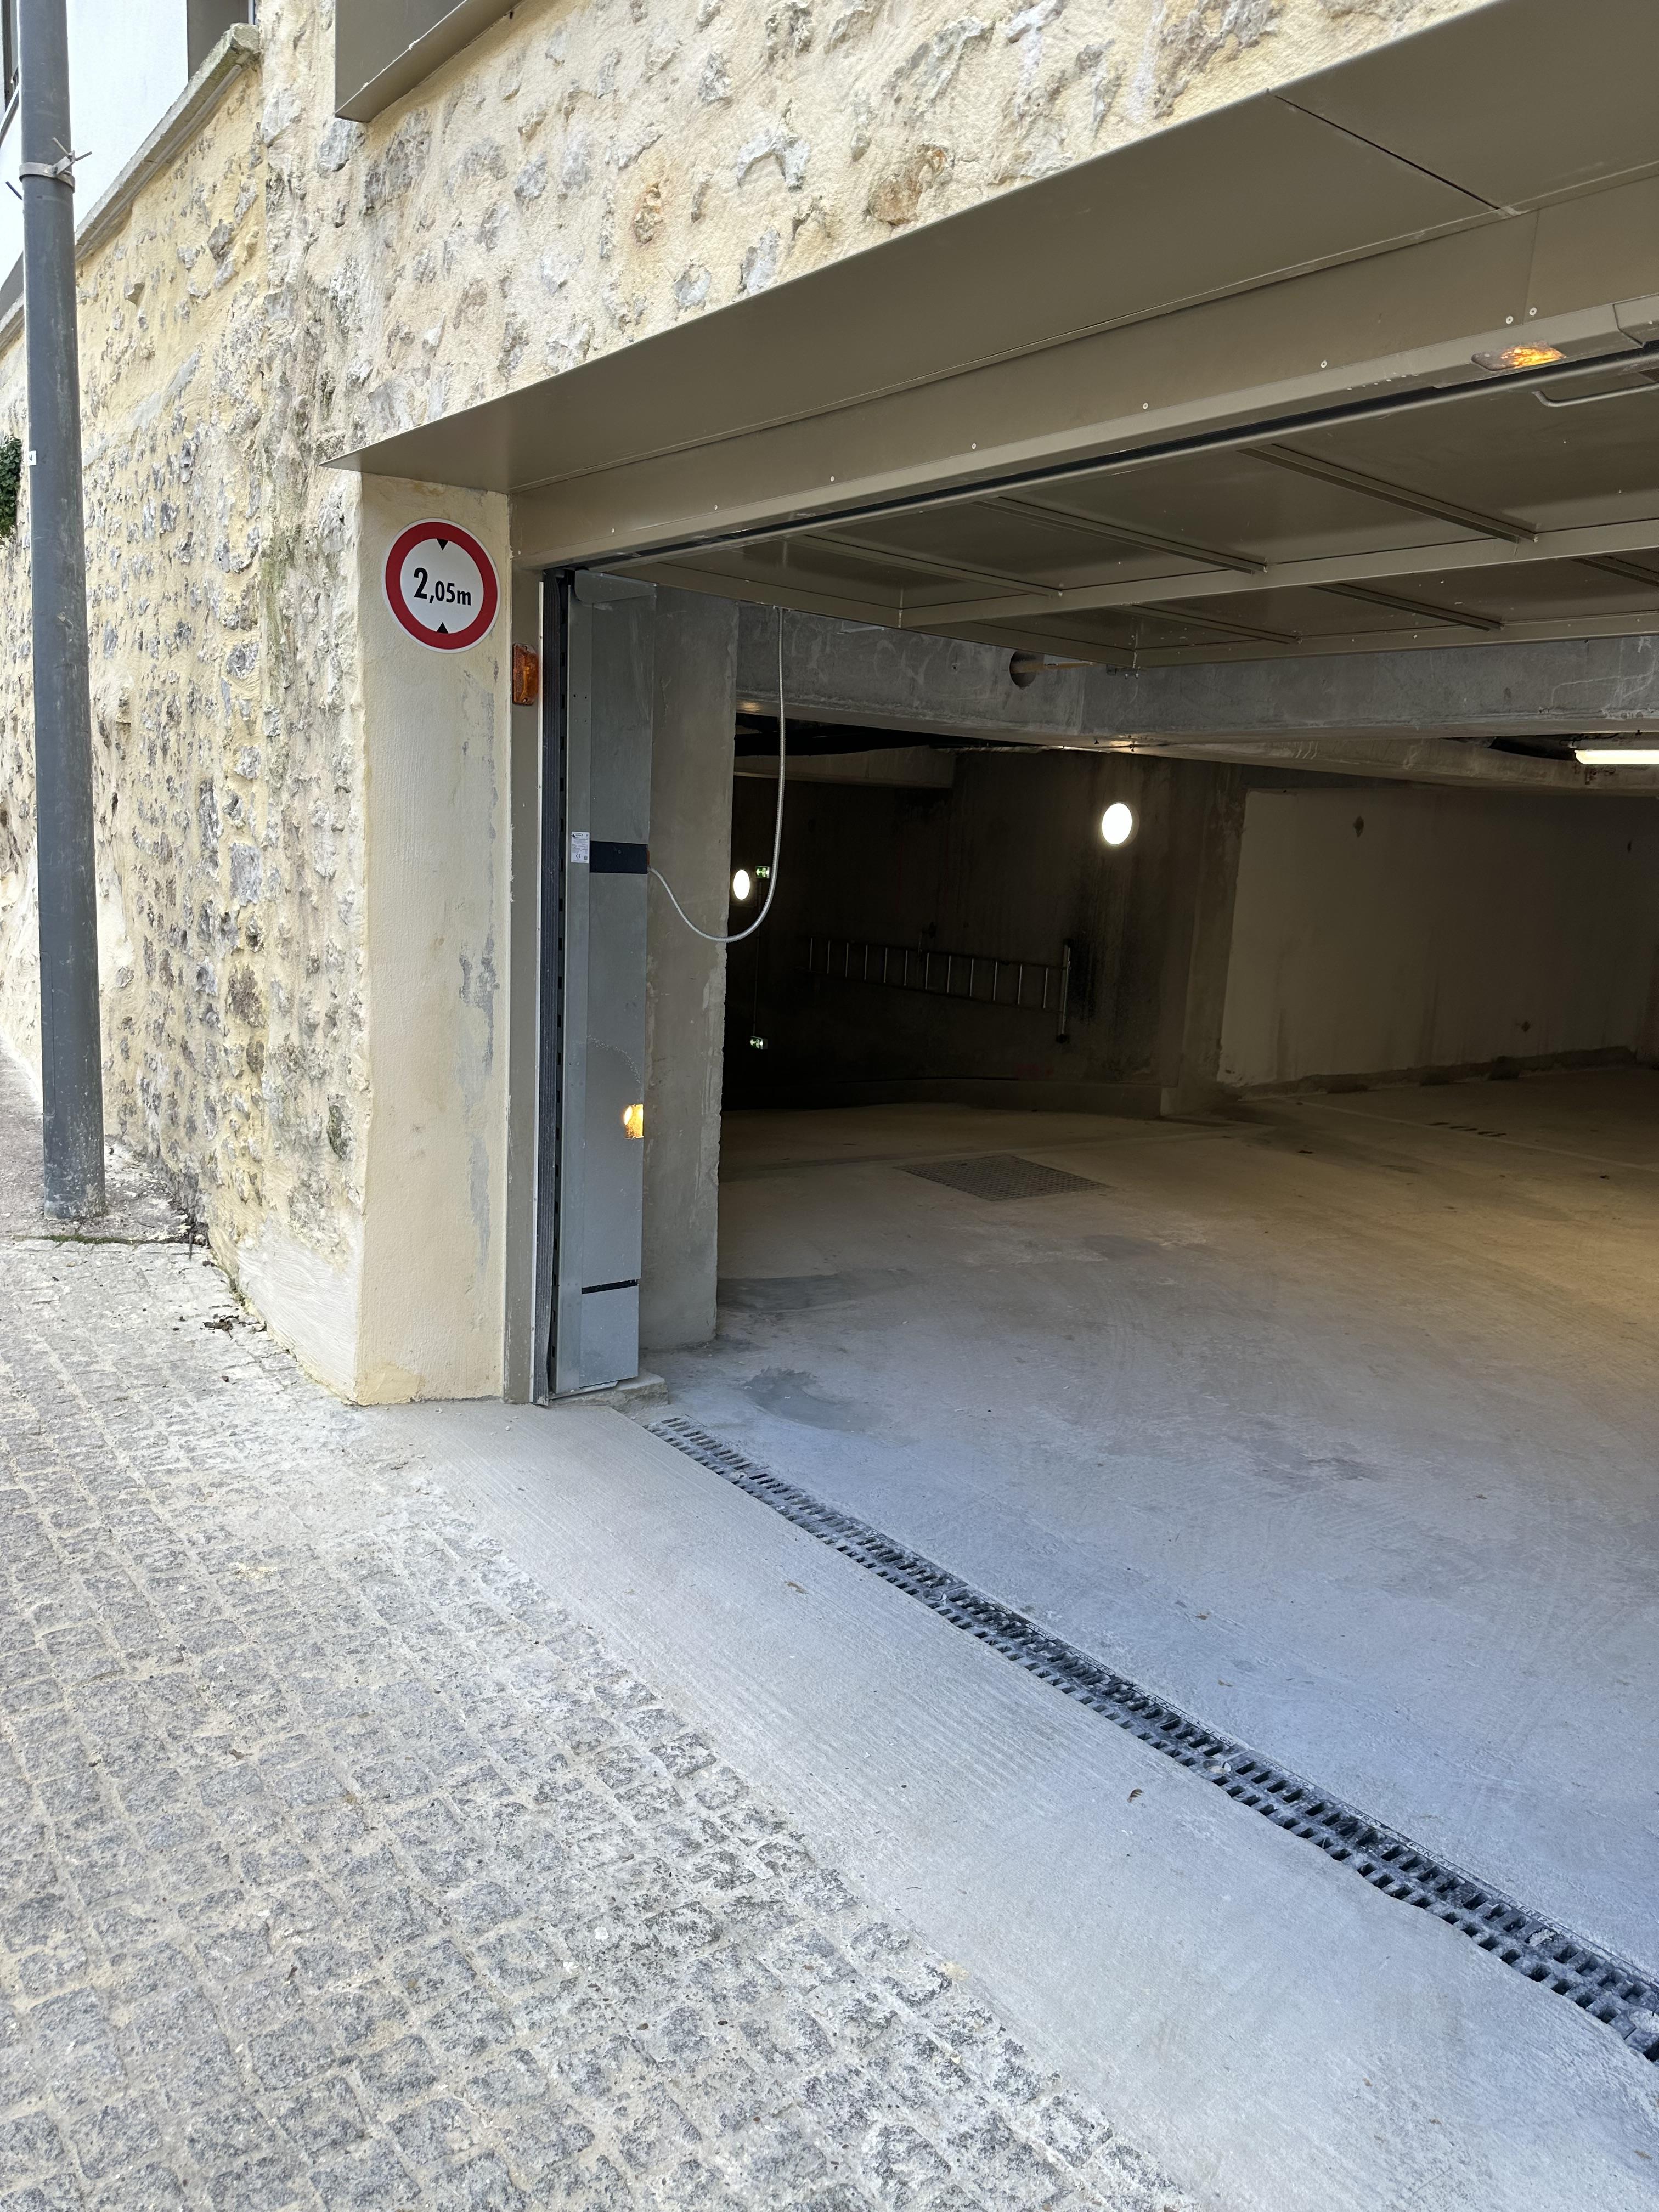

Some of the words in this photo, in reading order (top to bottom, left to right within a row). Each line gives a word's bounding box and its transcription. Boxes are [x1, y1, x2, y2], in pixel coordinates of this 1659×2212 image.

[414, 567, 471, 606] 2,05m
[1409, 1843, 1468, 1876] FONDAT
[1519, 1905, 1537, 1916] EN
